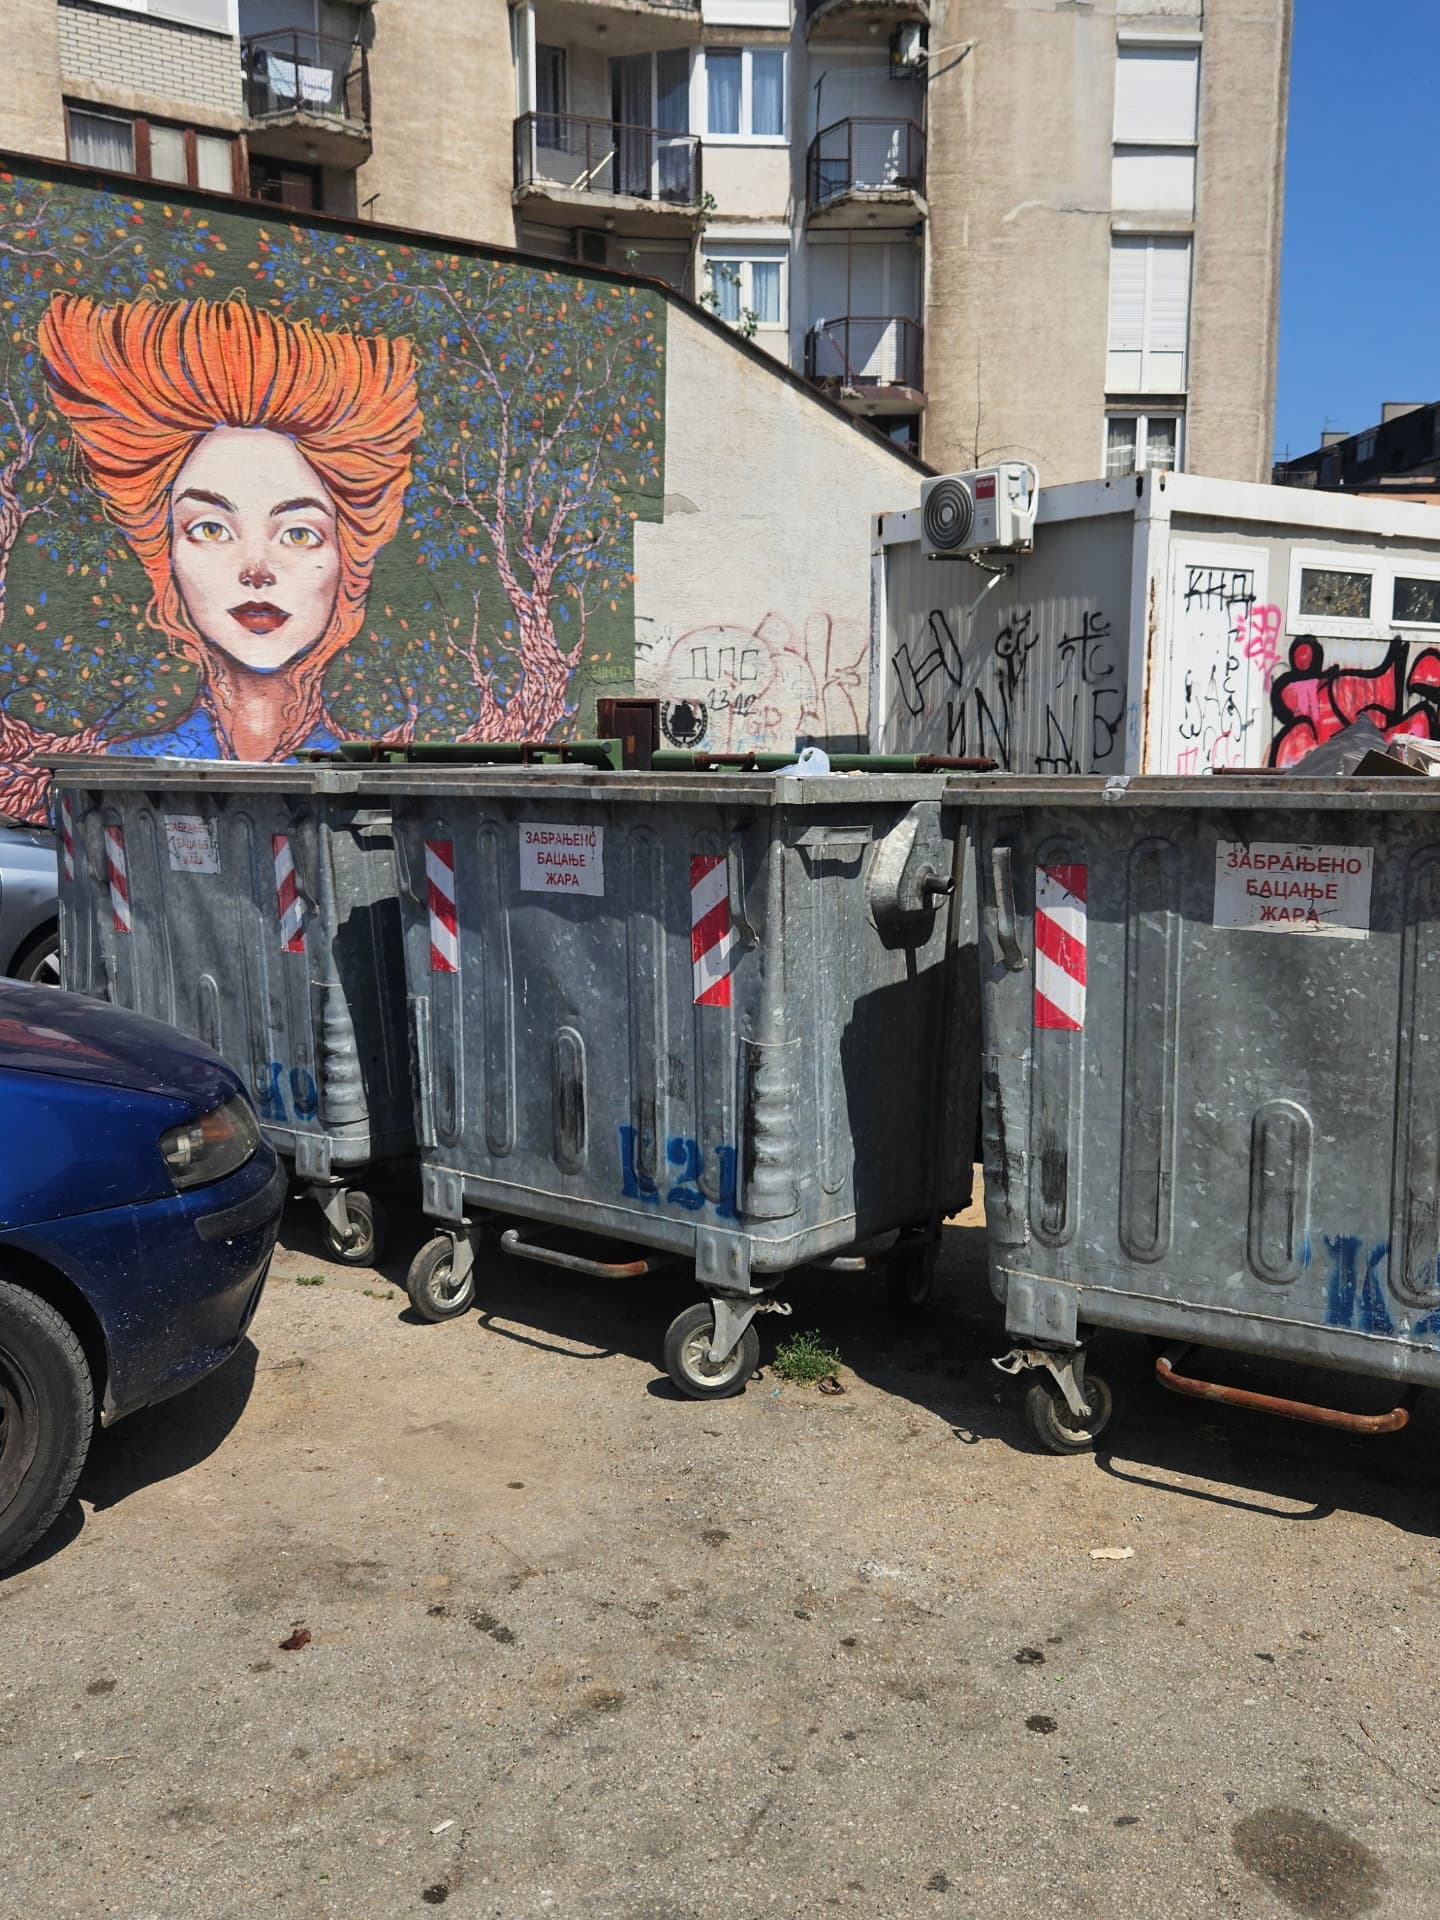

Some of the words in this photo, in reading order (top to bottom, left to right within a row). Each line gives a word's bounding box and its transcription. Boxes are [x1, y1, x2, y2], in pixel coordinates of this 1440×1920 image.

[525, 831, 597, 848] ЗАБРАЊЕНО
[537, 852, 586, 868] БАЦАЊЕ
[1227, 852, 1362, 875] ЗАБРАЊЕНО
[545, 871, 580, 888] ЖАРА
[1246, 879, 1339, 900] БАЦАЊЕ
[1259, 904, 1320, 924] ЖАРА
